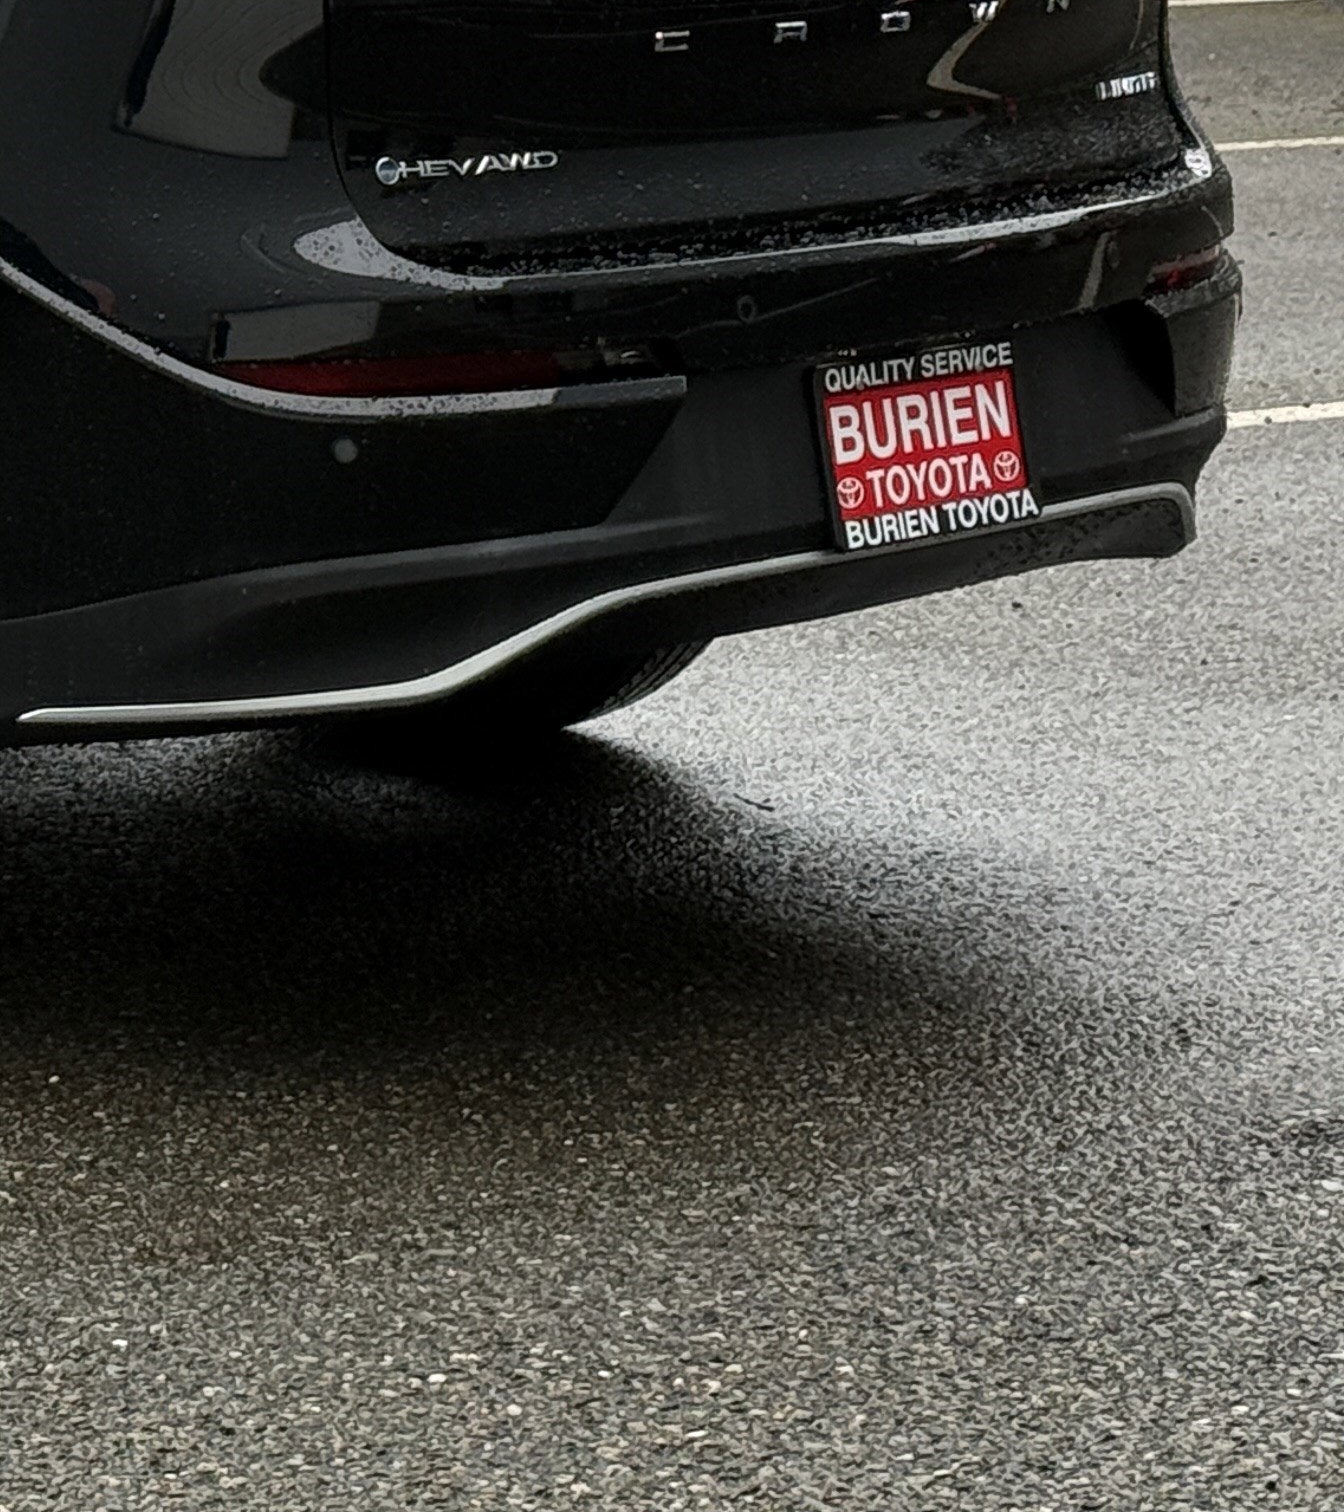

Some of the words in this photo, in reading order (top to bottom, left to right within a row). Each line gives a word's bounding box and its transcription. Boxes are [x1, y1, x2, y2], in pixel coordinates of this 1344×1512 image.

[824, 356, 914, 393] QUALITY
[920, 341, 1013, 378] SERVICE
[828, 380, 1012, 466] BURIEN
[865, 452, 992, 508] TOYOTA
[844, 506, 940, 550] BURIEN
[942, 488, 1040, 531] TOYOTA
